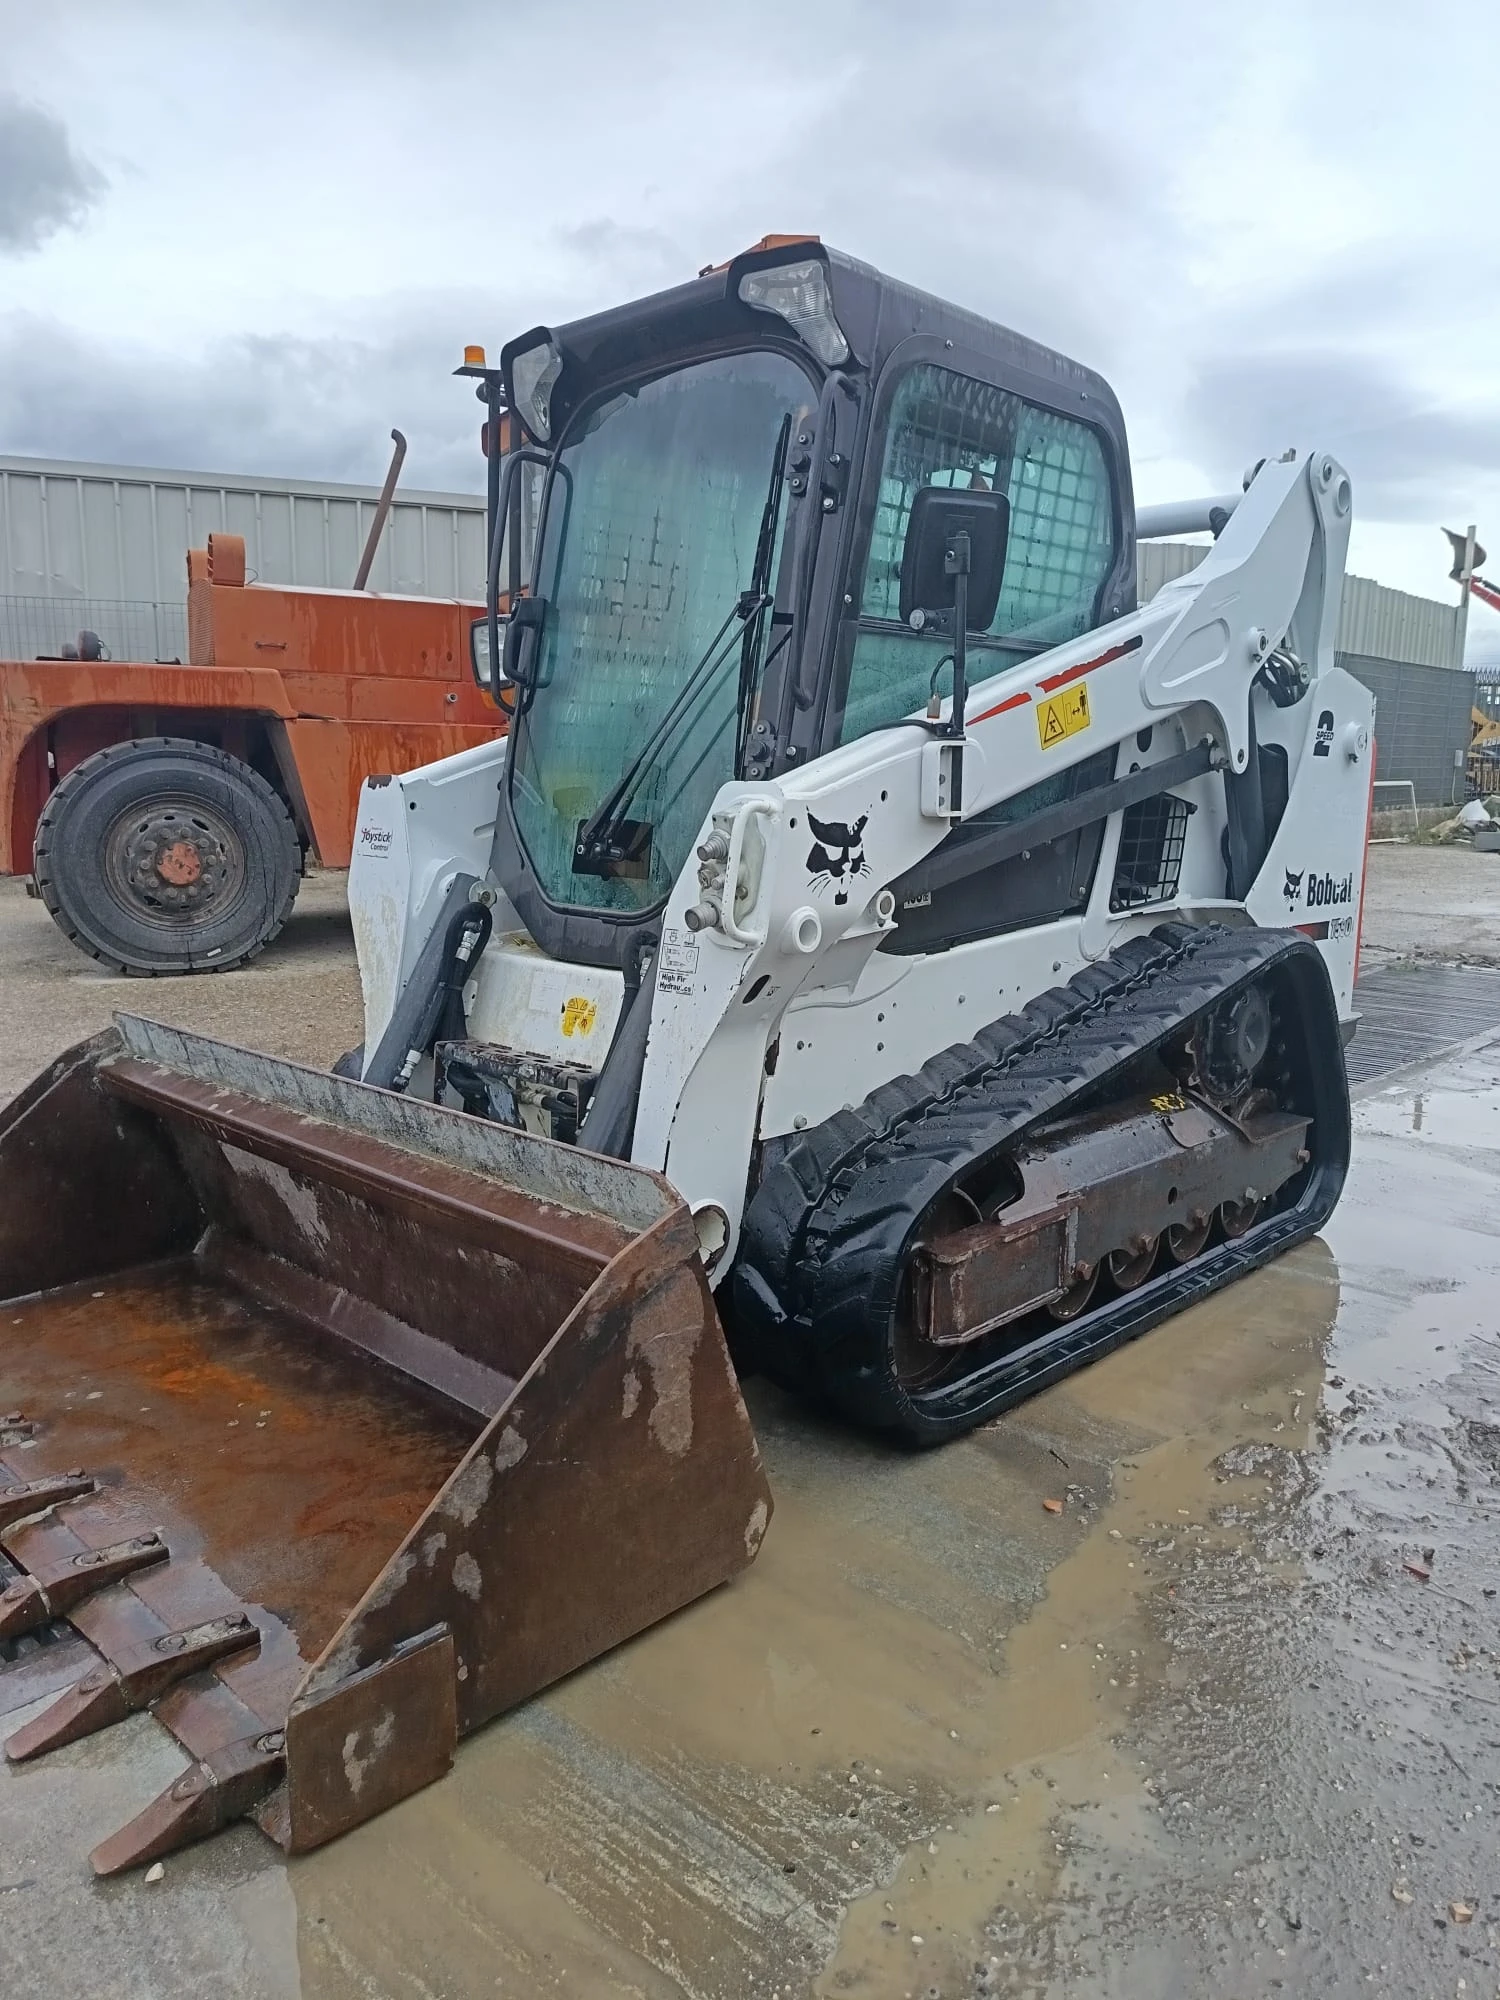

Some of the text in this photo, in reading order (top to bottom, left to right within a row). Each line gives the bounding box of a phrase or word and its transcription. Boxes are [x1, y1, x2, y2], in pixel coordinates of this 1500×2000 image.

[1315, 730, 1335, 741] SPEED
[1307, 872, 1353, 907] Bobcat
[661, 973, 676, 982] High
